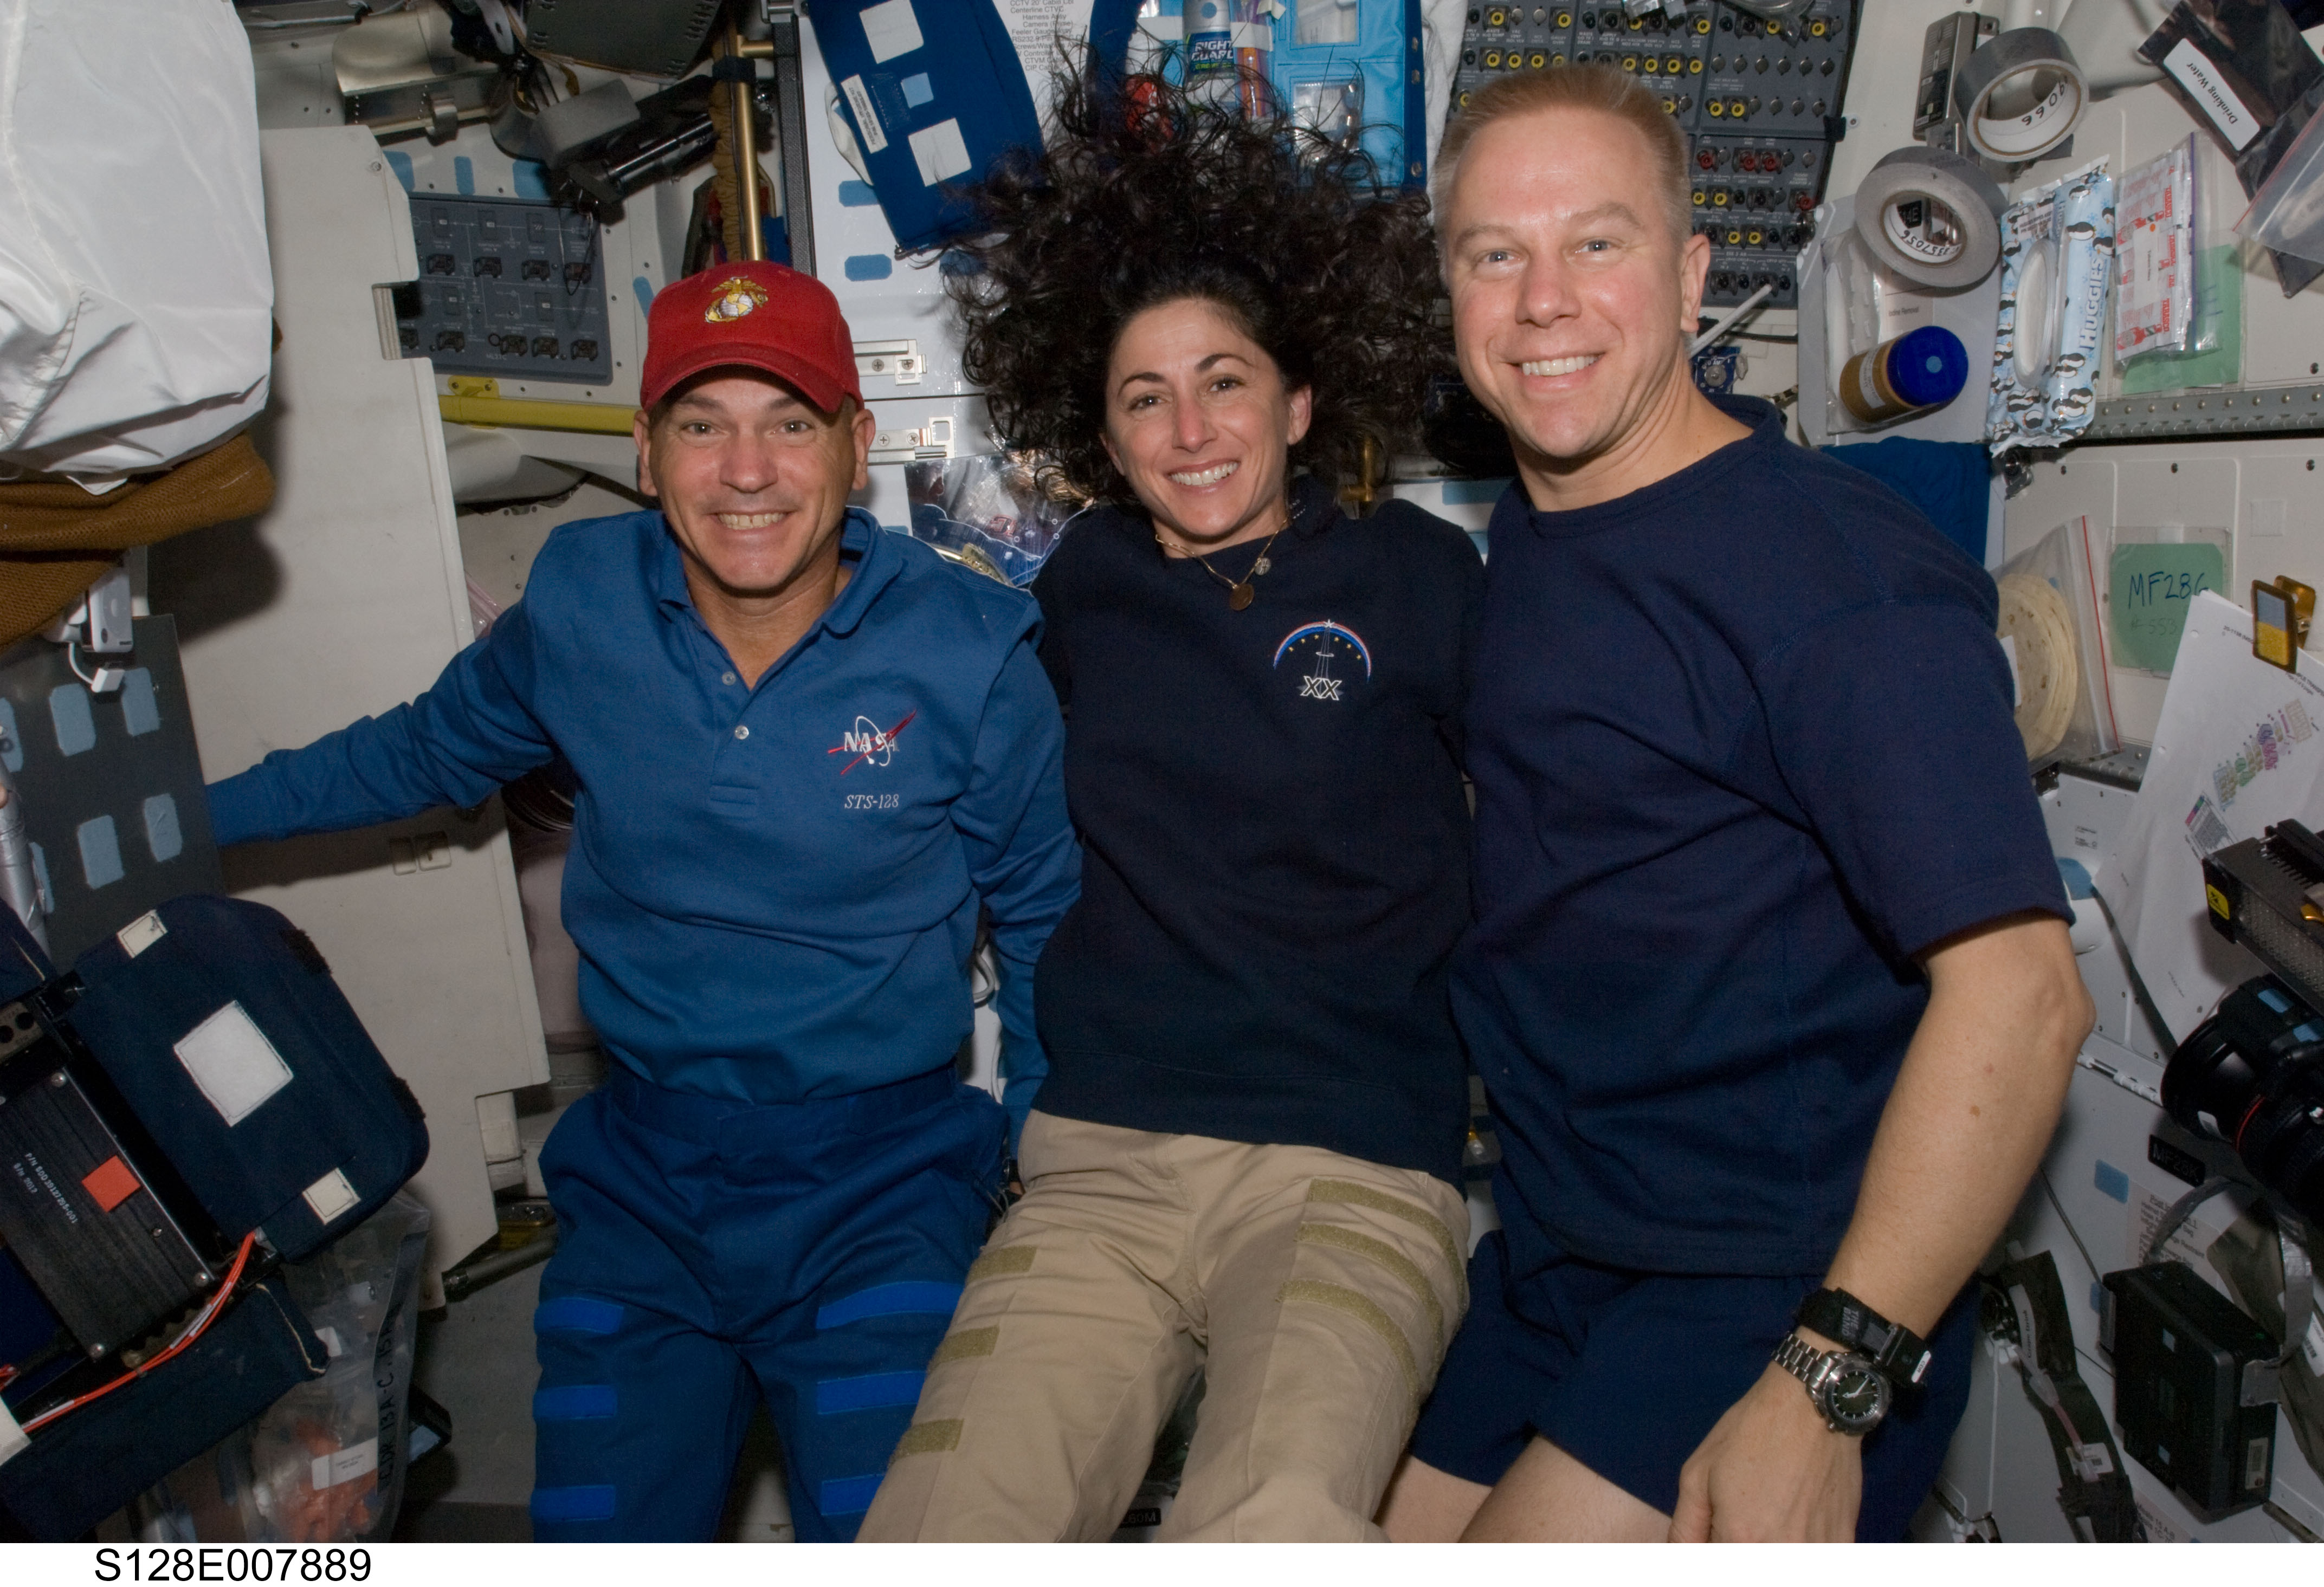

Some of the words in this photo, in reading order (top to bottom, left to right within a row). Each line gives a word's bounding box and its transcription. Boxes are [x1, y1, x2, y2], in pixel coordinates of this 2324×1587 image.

[2187, 62, 2209, 89] Water
[2207, 86, 2238, 125] Drinking
[1901, 306, 1920, 314] Removal
[2079, 258, 2104, 352] HUGGIES
[844, 731, 900, 753] NASA
[844, 794, 900, 809] STS-128
